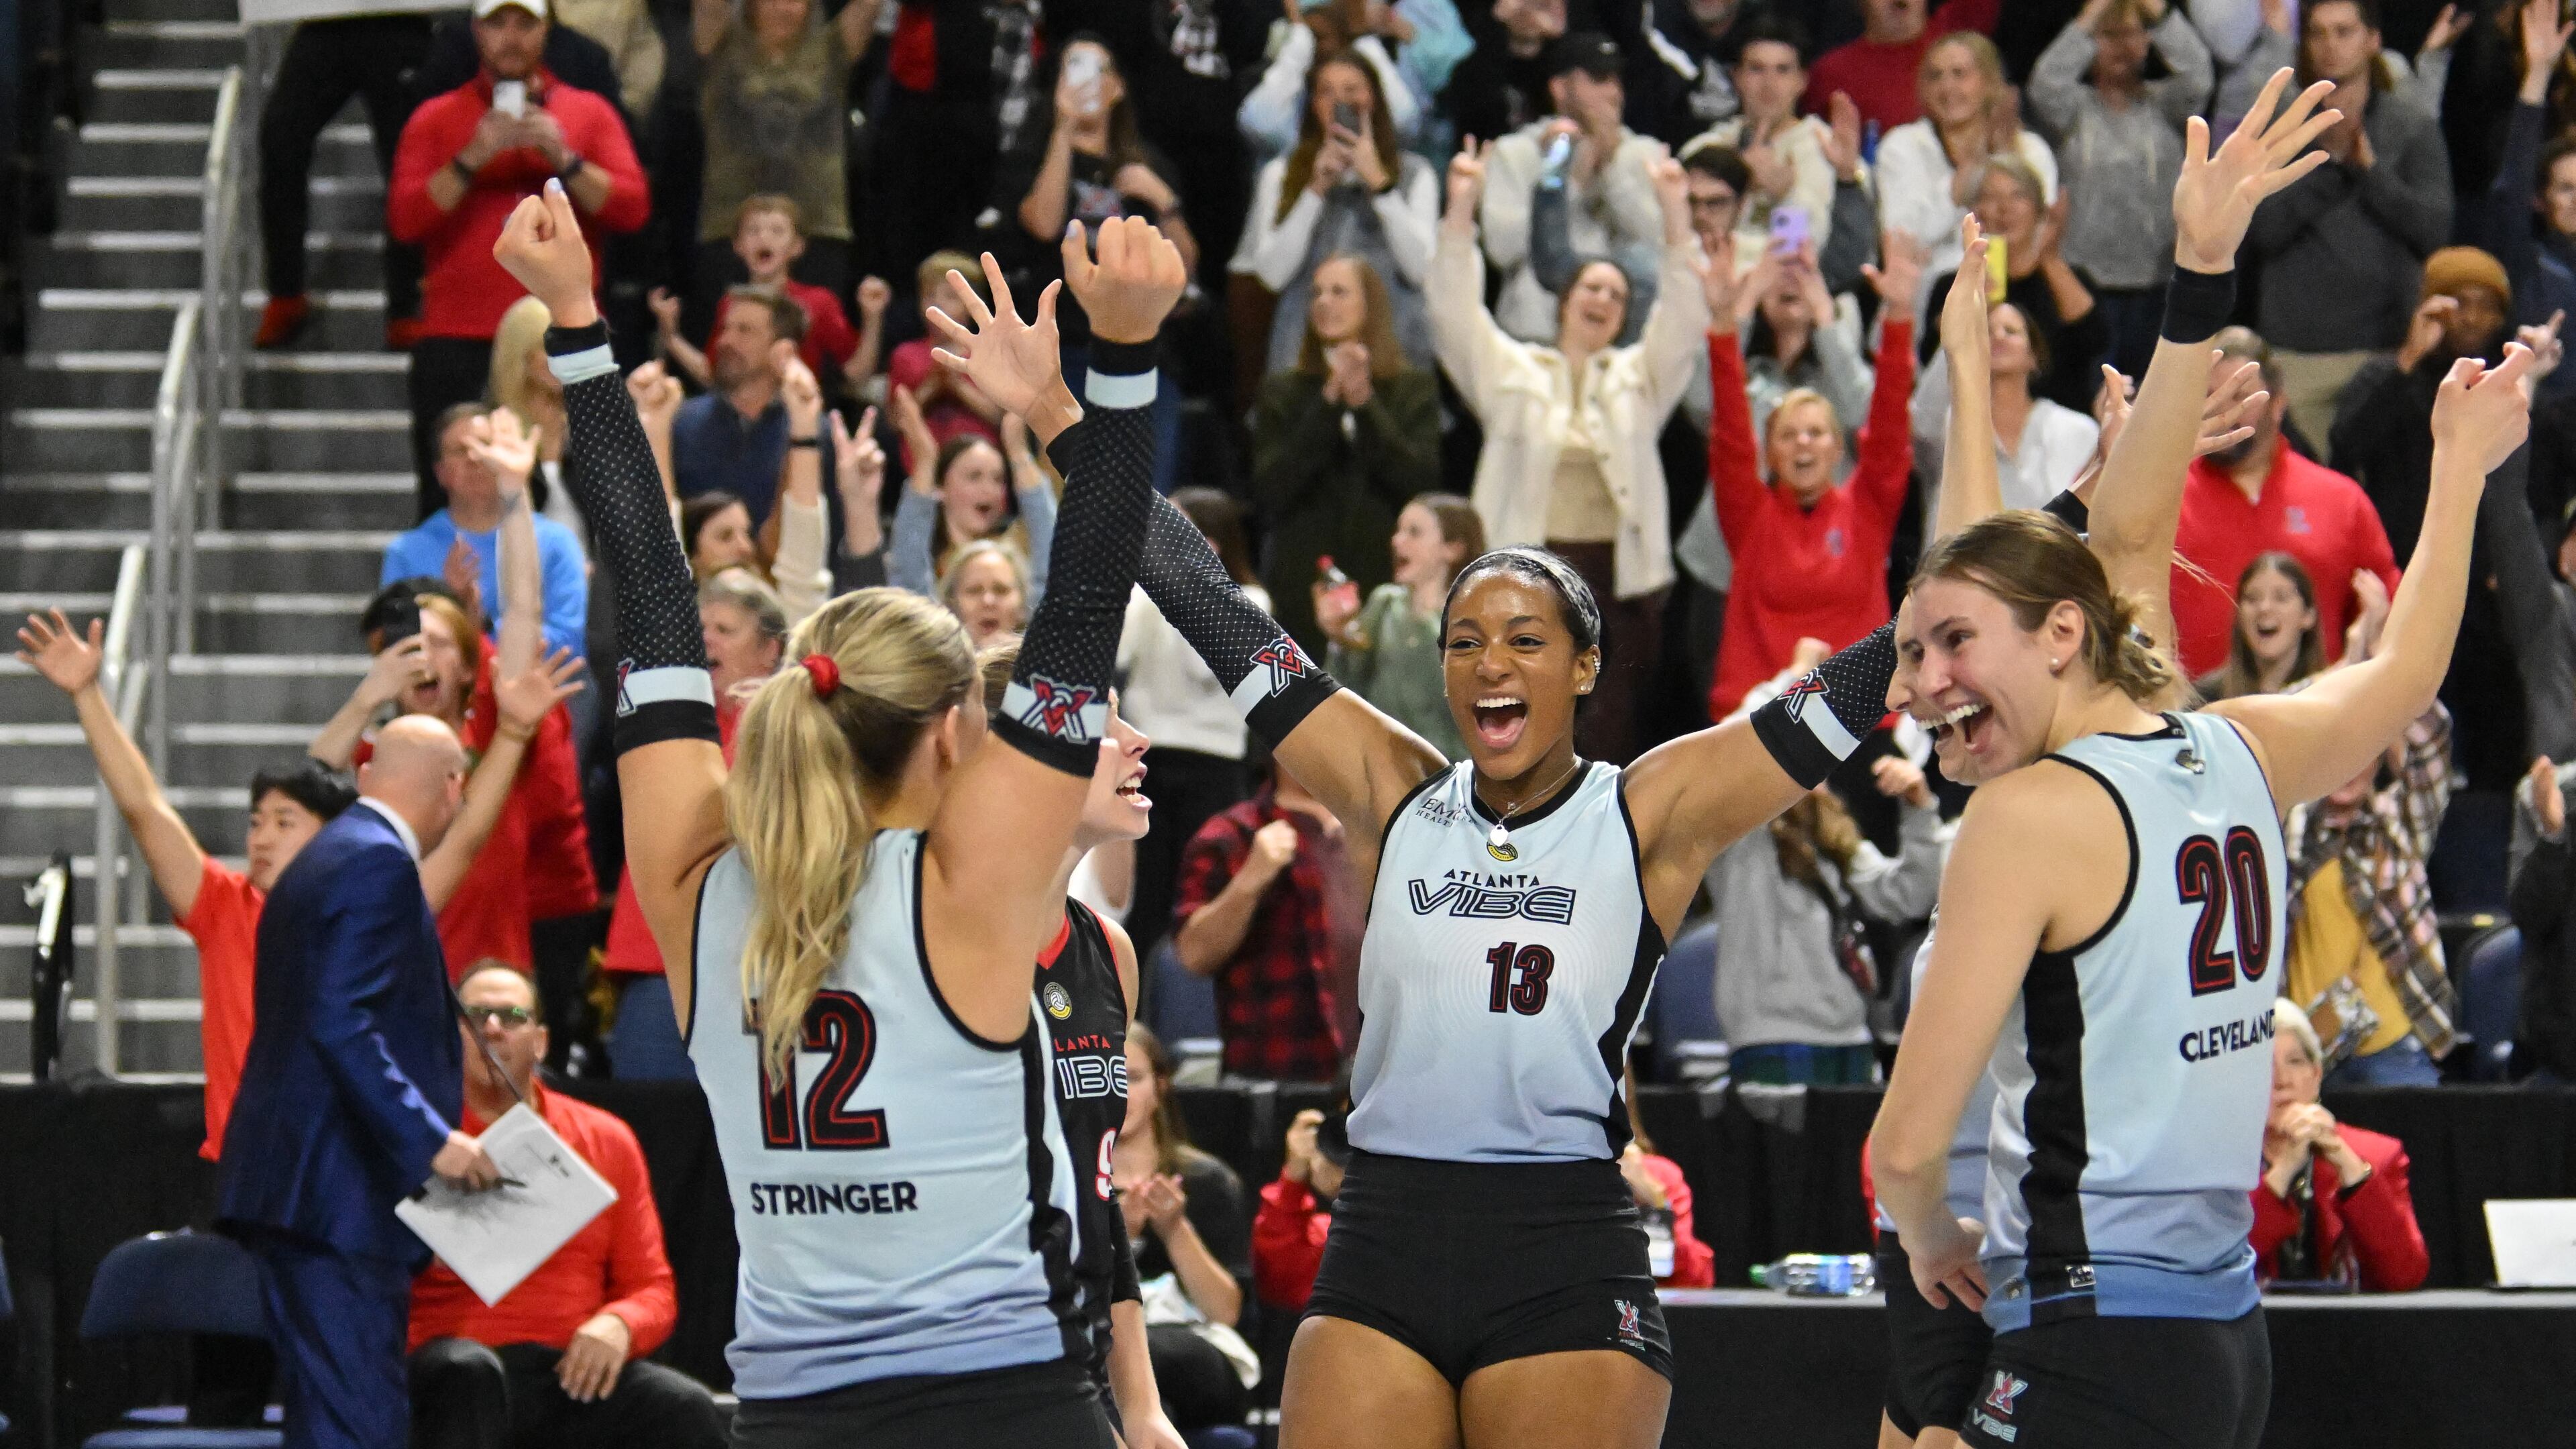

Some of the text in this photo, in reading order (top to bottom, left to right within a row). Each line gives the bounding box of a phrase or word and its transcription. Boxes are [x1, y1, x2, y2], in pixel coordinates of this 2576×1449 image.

[1444, 869, 1540, 888] ATLANTA
[1408, 879, 1576, 925] VIBE
[2176, 825, 2271, 998] 20
[1486, 941, 1555, 1016] 13
[1055, 1035, 1111, 1052] LANTA
[2180, 1008, 2275, 1063] CLEVELAND
[742, 989, 891, 1150] 12
[1055, 1055, 1128, 1099] IBE
[751, 1181, 918, 1216] STRINGER
[1974, 1407, 2017, 1442] VIBE
